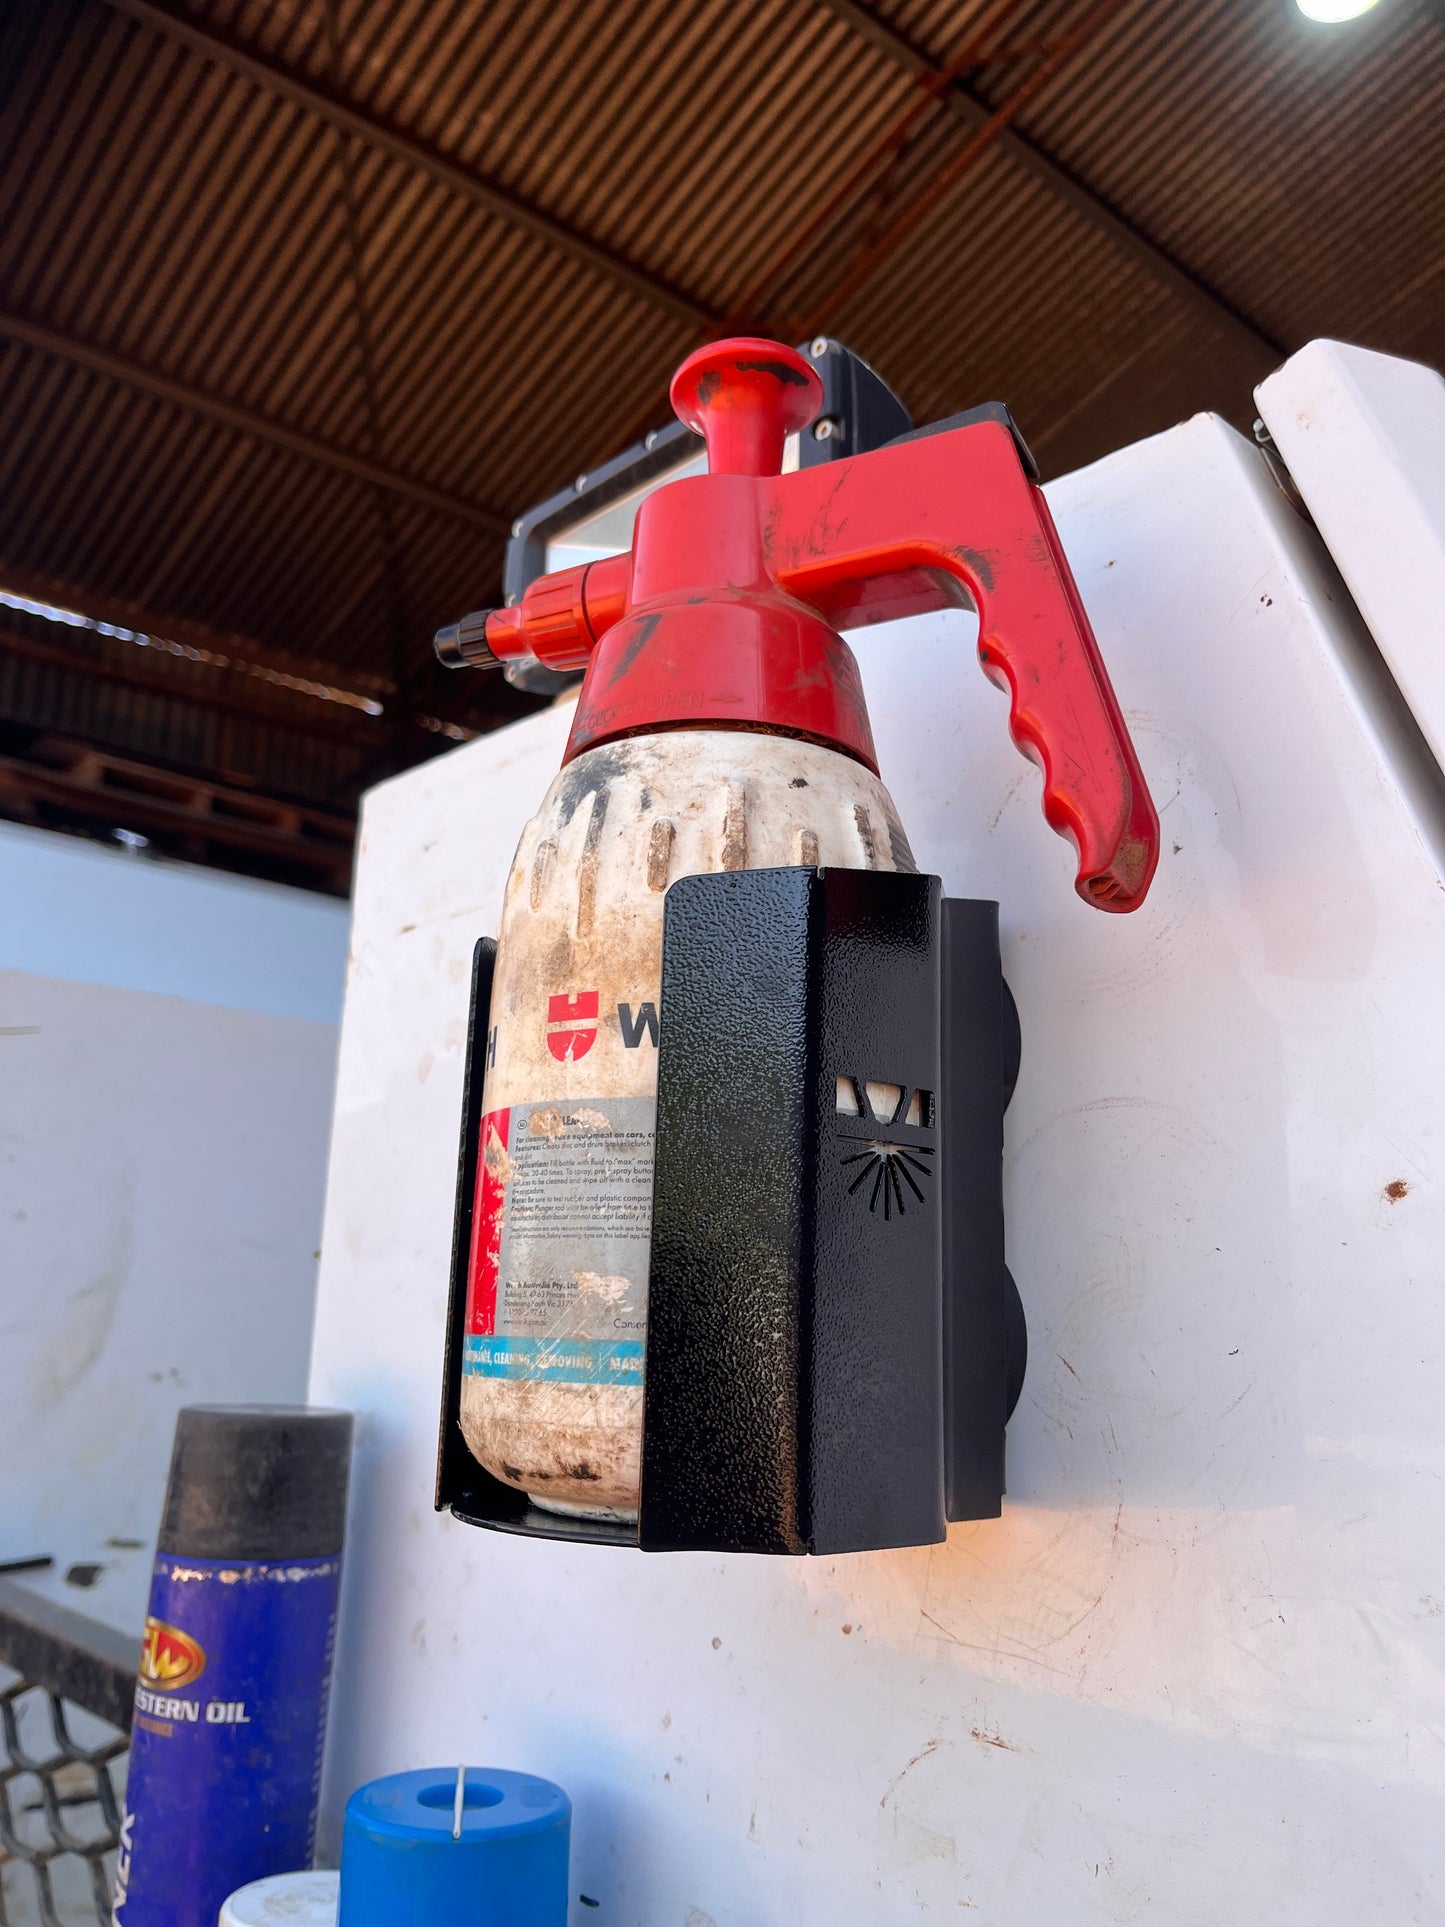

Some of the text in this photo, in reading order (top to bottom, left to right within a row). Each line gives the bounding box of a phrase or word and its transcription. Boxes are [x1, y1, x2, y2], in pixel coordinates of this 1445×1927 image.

[626, 1132, 646, 1140] cars,
[630, 1139, 651, 1147] clutch
[612, 1168, 632, 1177] spray
[631, 1175, 652, 1184] clean
[599, 1193, 622, 1203] plastic
[614, 1231, 629, 1239] label
[551, 1281, 566, 1291] Pty.
[204, 1700, 252, 1724] OIL
